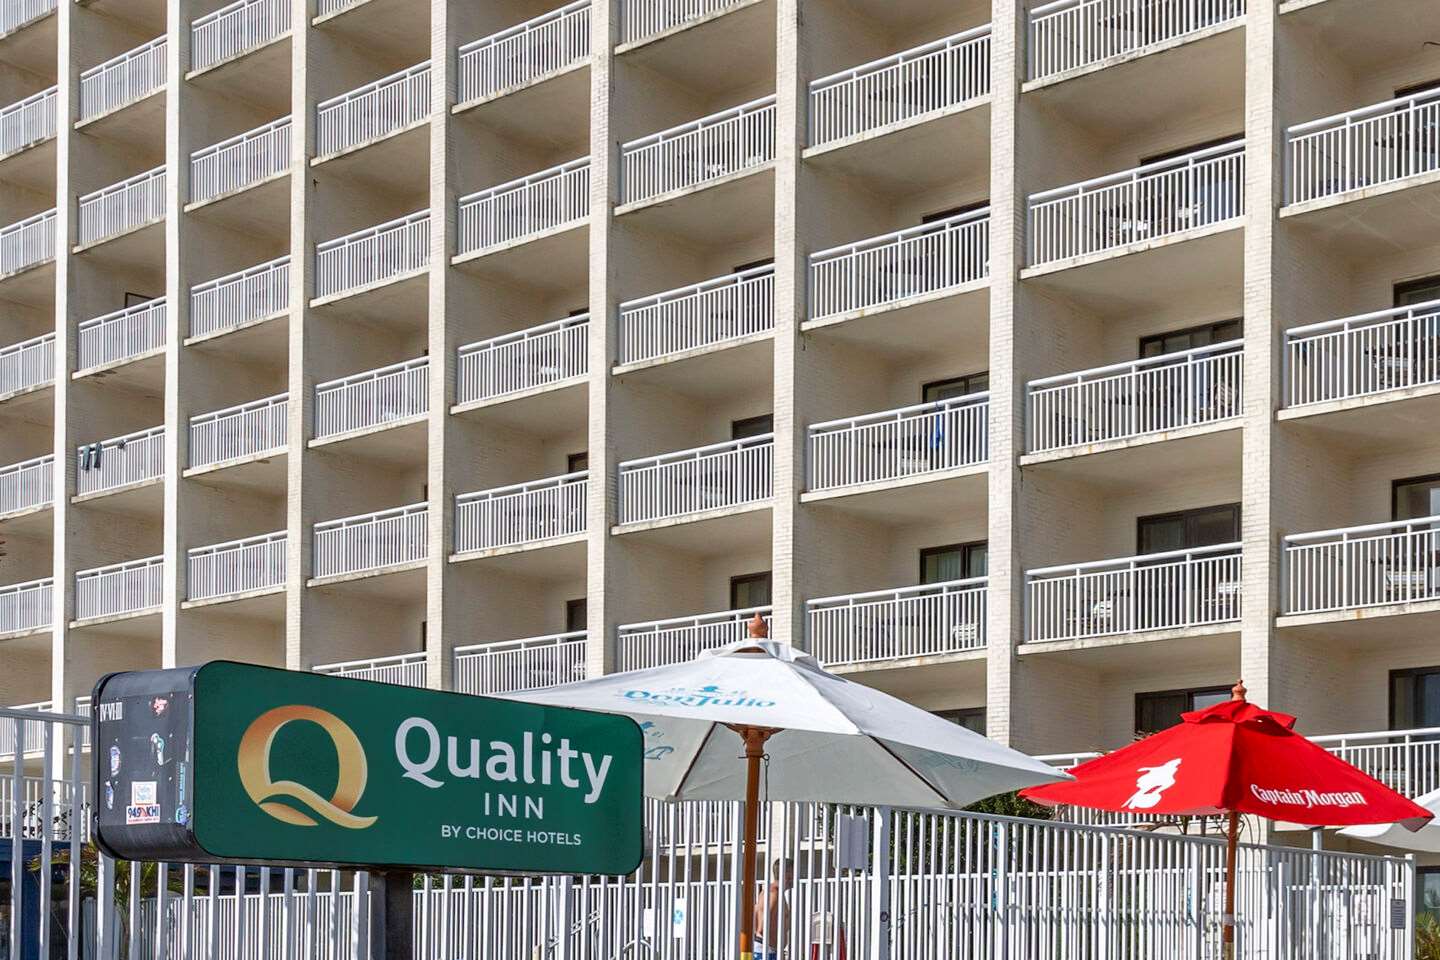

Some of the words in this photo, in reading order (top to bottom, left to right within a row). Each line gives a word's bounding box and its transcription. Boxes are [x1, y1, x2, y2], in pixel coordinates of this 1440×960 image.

[395, 716, 613, 804] Quality
[484, 792, 544, 820] INN
[1250, 783, 1305, 806] Captain
[1299, 789, 1368, 809] Morgan
[441, 824, 462, 839] BY
[466, 826, 522, 842] CHOICE
[527, 831, 582, 846] HOTELS
